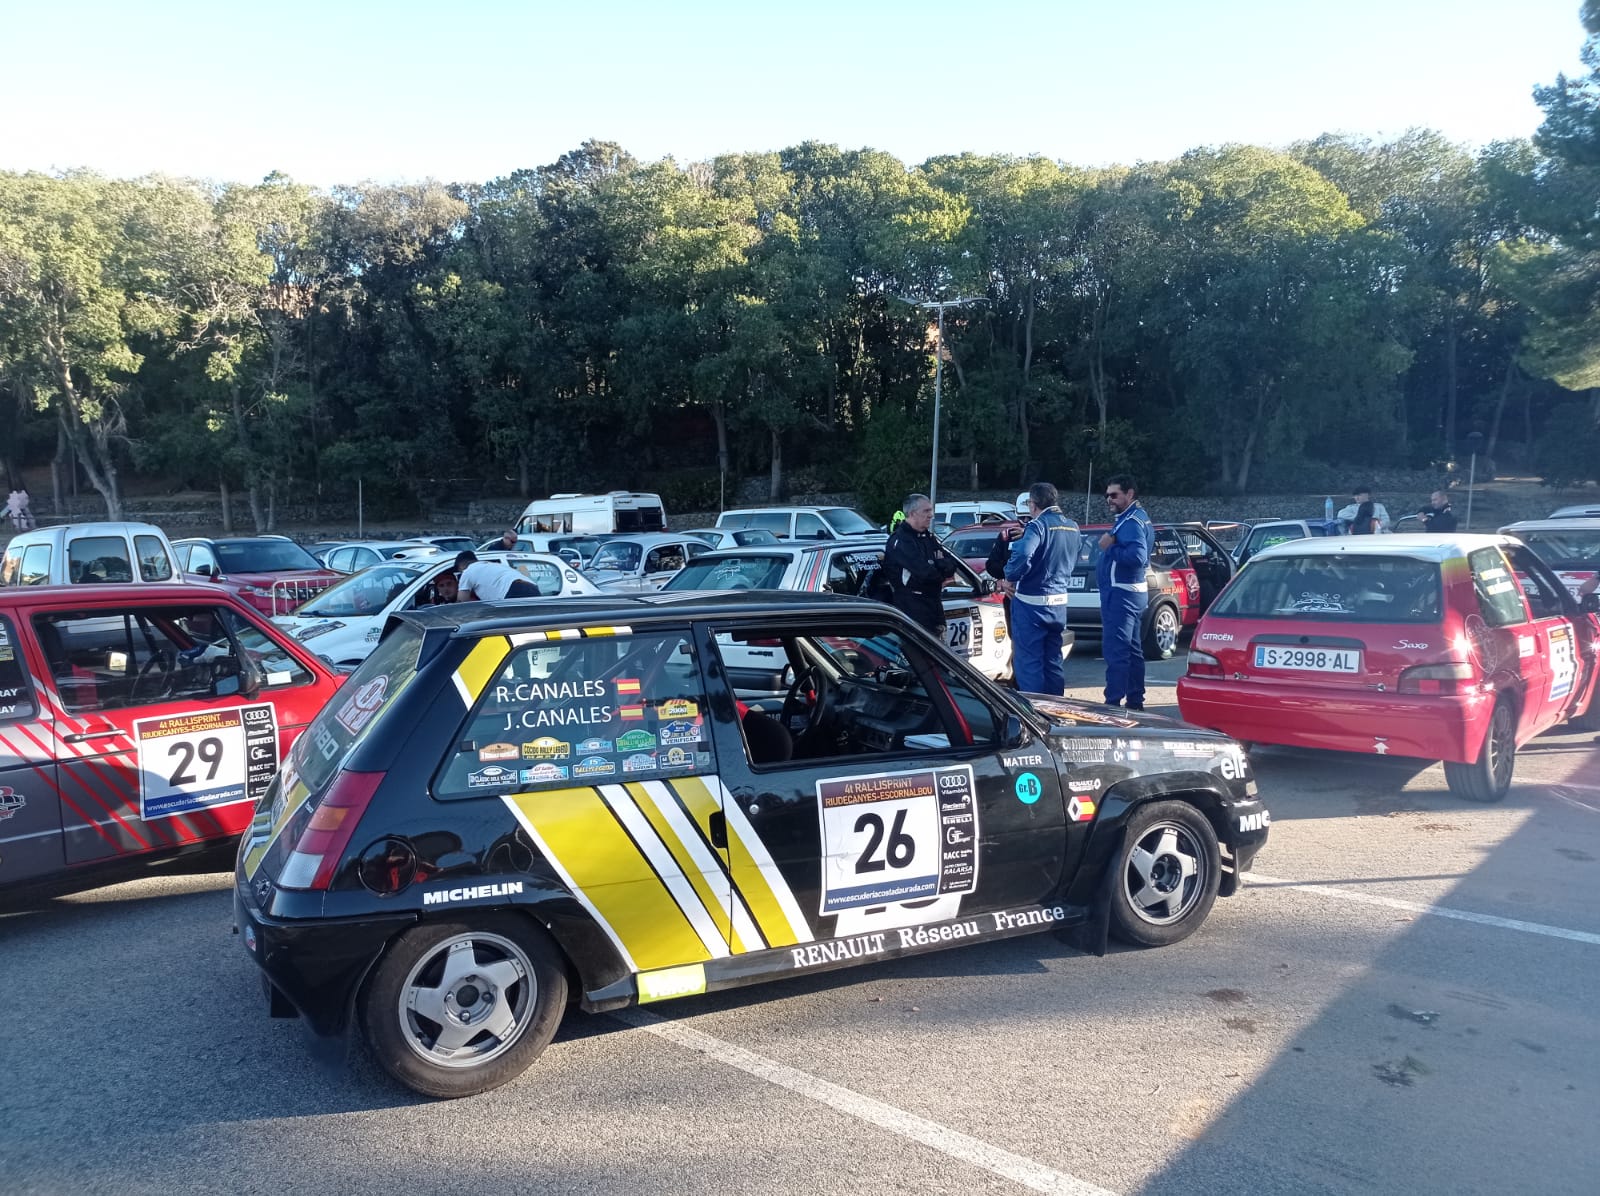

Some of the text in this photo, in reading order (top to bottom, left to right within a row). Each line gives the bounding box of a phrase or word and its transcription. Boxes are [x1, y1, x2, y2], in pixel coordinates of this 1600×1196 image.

[950, 621, 968, 647] 28
[1201, 633, 1234, 642] CITROËN
[1392, 639, 1429, 650] Saxo
[496, 679, 606, 703] R.CANALES
[504, 705, 613, 731] J.CANALES
[665, 736, 697, 744] VERIFICAT
[168, 737, 224, 787] 29
[1003, 755, 1042, 767] MATTER
[825, 787, 933, 807] RIUDECANYES-ESCORNALBOU
[854, 808, 916, 874] 26
[943, 850, 960, 860] RACC
[943, 865, 973, 875] RALARSA
[423, 881, 523, 905] MICHELIN
[828, 883, 935, 905] www.escuderiacostadaurada.com
[791, 904, 1065, 969] RENAULT Réseau France
